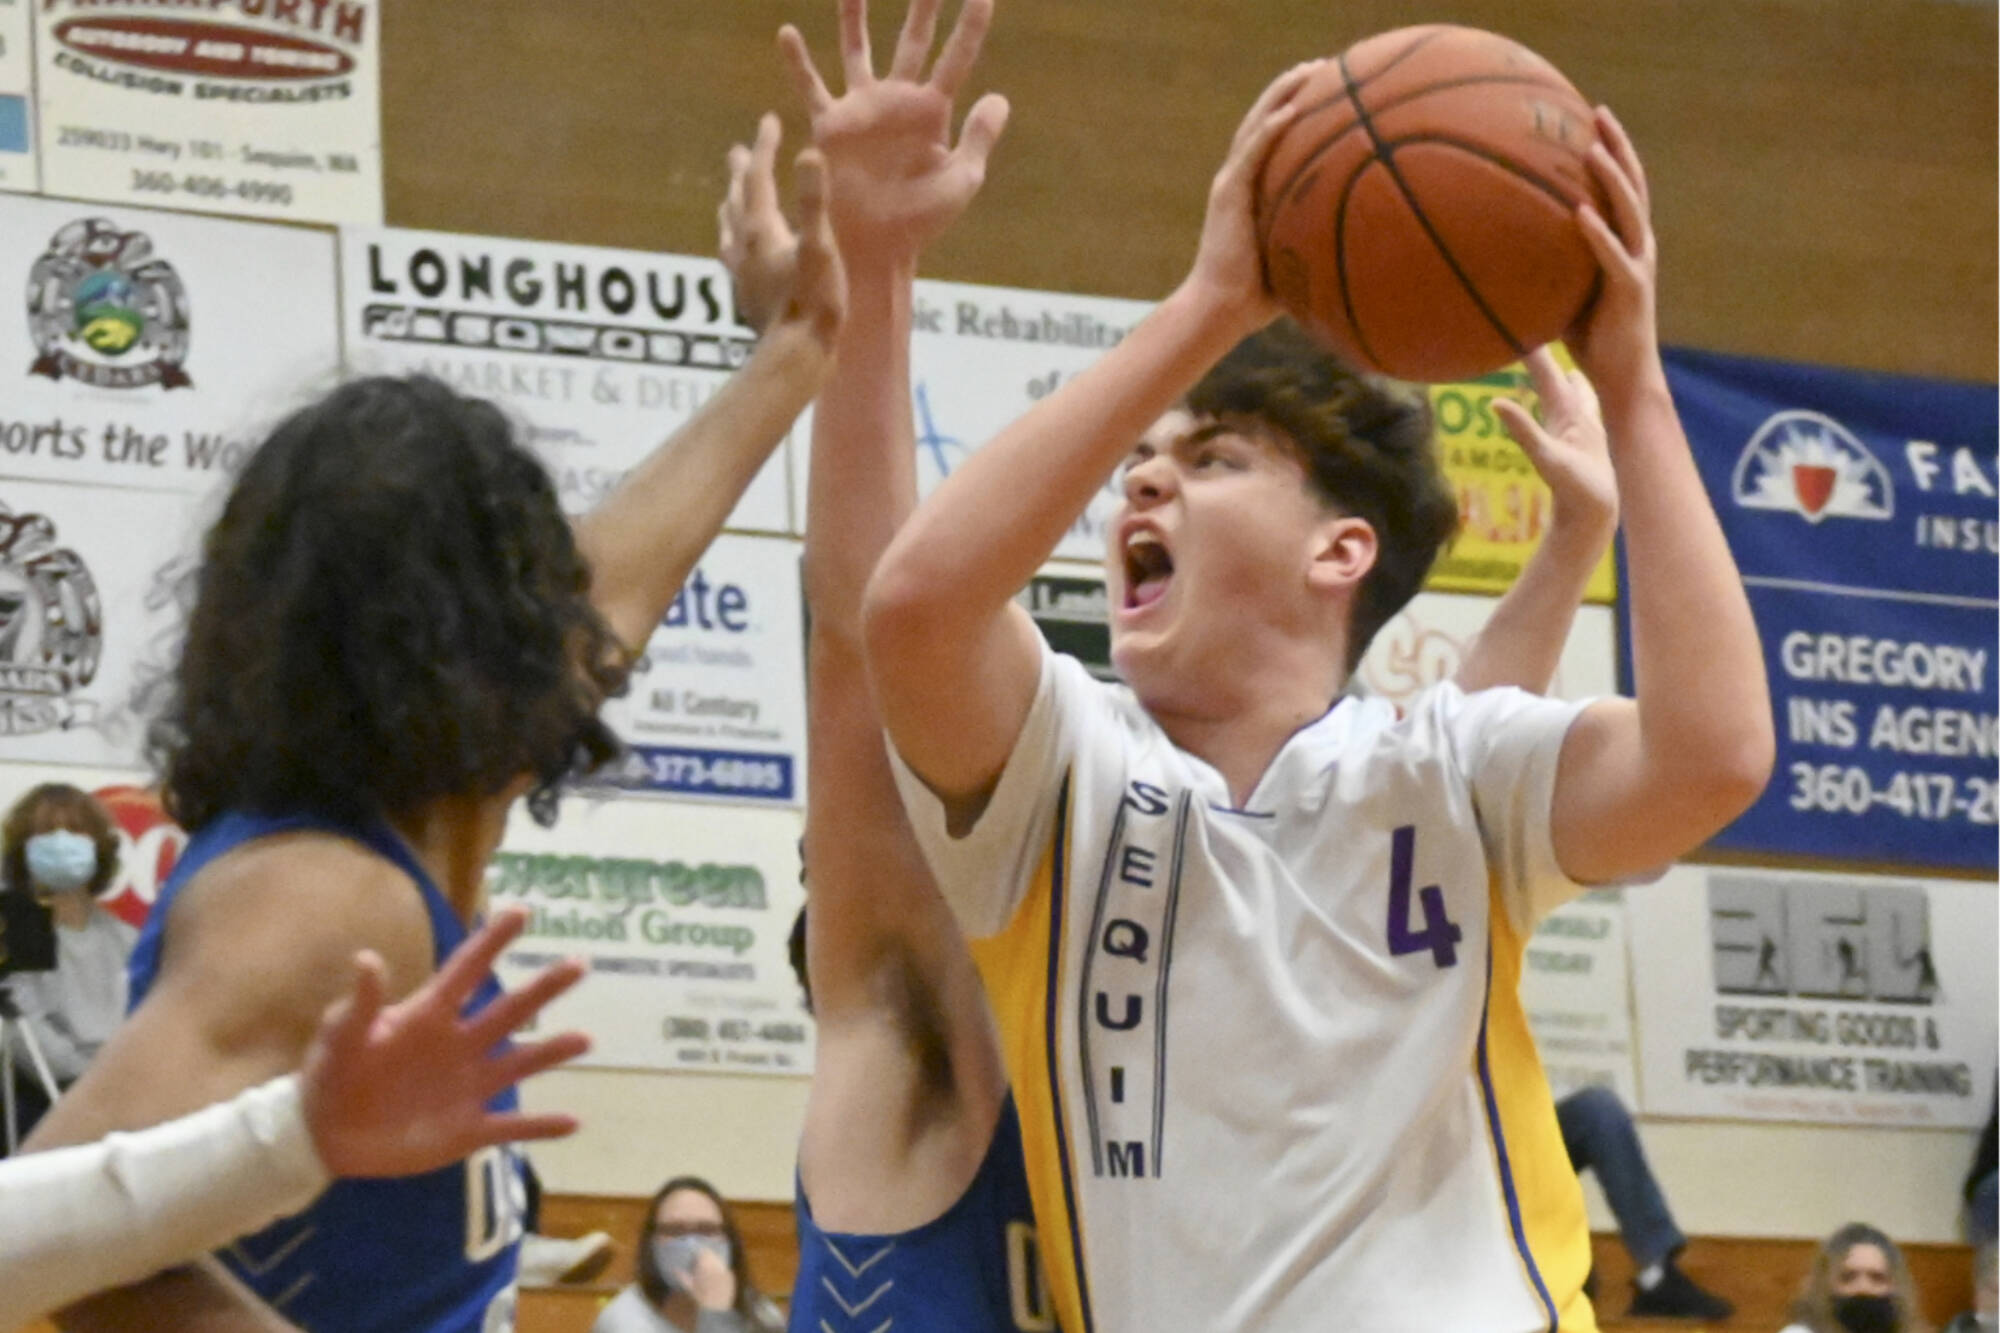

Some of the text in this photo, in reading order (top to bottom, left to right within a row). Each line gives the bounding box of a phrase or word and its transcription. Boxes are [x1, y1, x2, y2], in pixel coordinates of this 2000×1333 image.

[53, 52, 352, 103] COLLISION SPECIALISTS
[368, 243, 746, 324] LONGHOUS
[0, 418, 86, 461] orts
[102, 423, 169, 468] the
[1780, 631, 1988, 692] GREGORY
[1788, 697, 1858, 748] INS
[1386, 824, 1463, 969] 4
[640, 907, 756, 956] Group
[1094, 778, 1171, 1179] SEQUIM
[1714, 1004, 1941, 1051] SPORTING GOODS &
[1684, 1048, 1974, 1098] PERFORMANCE TRAINING
